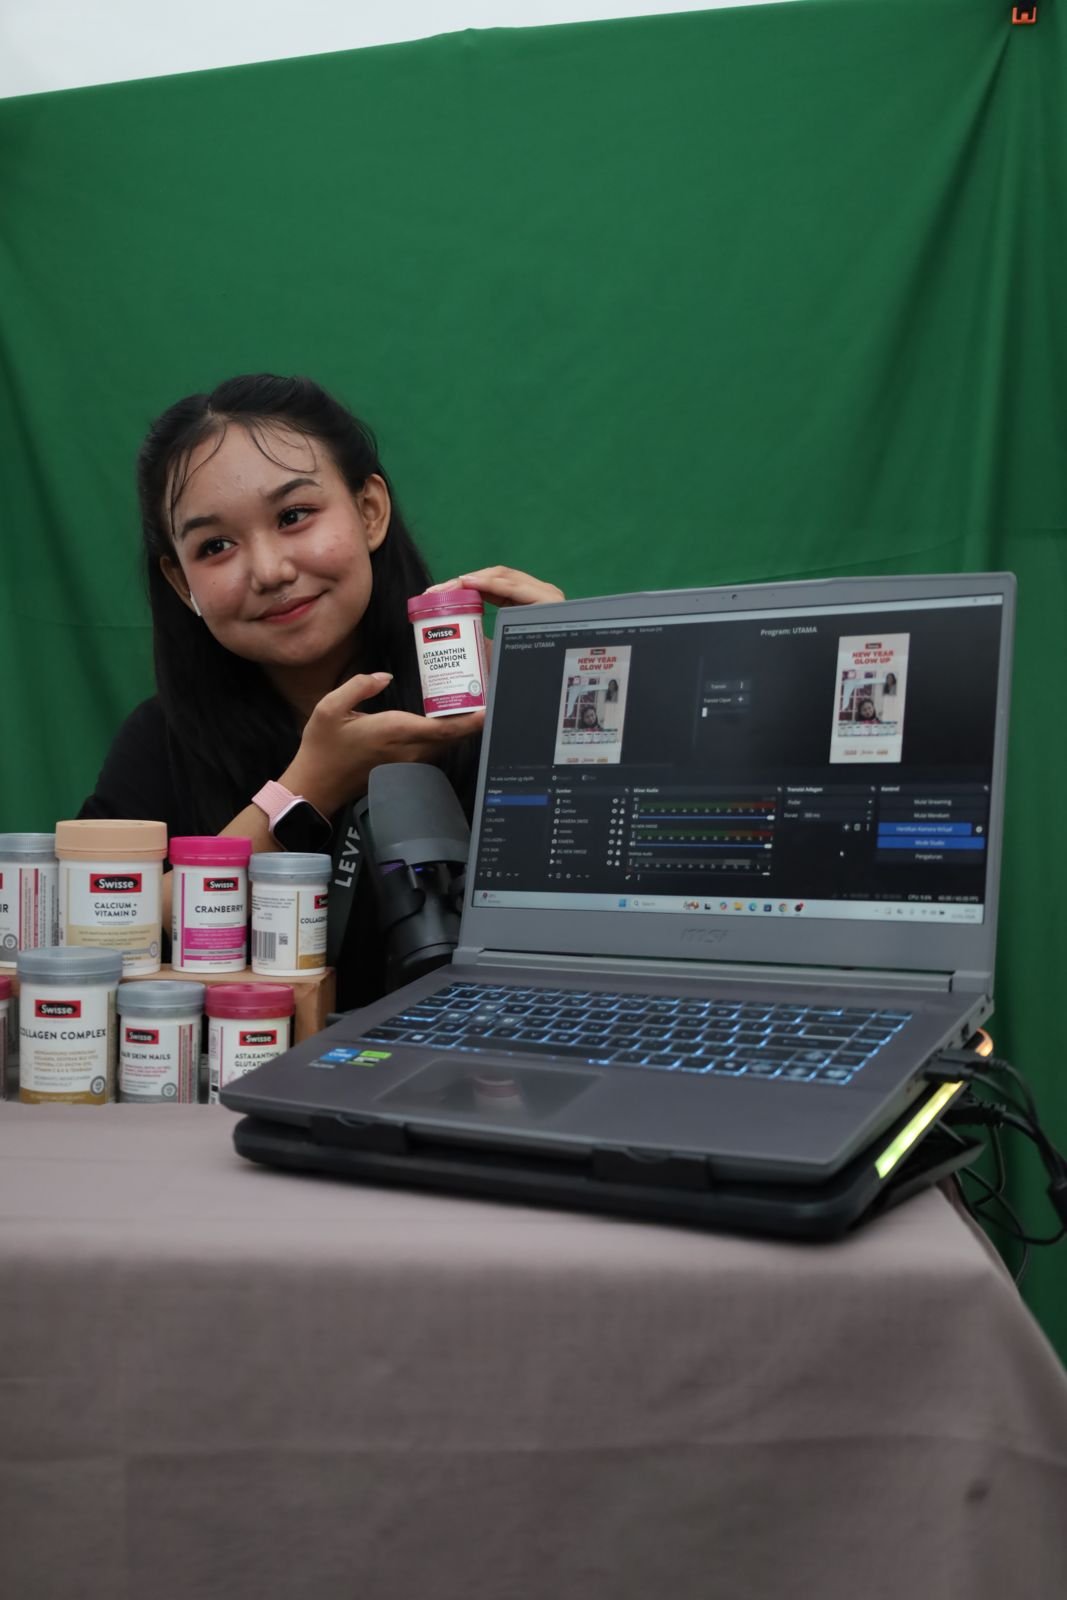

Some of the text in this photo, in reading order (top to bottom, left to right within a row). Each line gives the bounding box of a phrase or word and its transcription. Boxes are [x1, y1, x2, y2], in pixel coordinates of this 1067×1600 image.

[426, 629, 454, 640] Swisse
[760, 626, 818, 637] Program: UTAMA
[423, 647, 466, 659] ASTAXANTHIN
[424, 653, 468, 666] GLUTATHIONE
[577, 657, 596, 665] NEW
[429, 661, 461, 671] COMPLEX
[98, 877, 135, 890] Swisse
[209, 880, 235, 890] Swisse
[94, 902, 132, 910] CALCIUM
[194, 904, 244, 913] CRANBERRY
[41, 1003, 74, 1015] Swisse
[60, 1028, 107, 1040] COMPLEX
[128, 1031, 154, 1042] Swisse
[246, 1034, 273, 1043] Swisse
[132, 1052, 147, 1060] SKIN
[149, 1053, 171, 1061] NAILS
